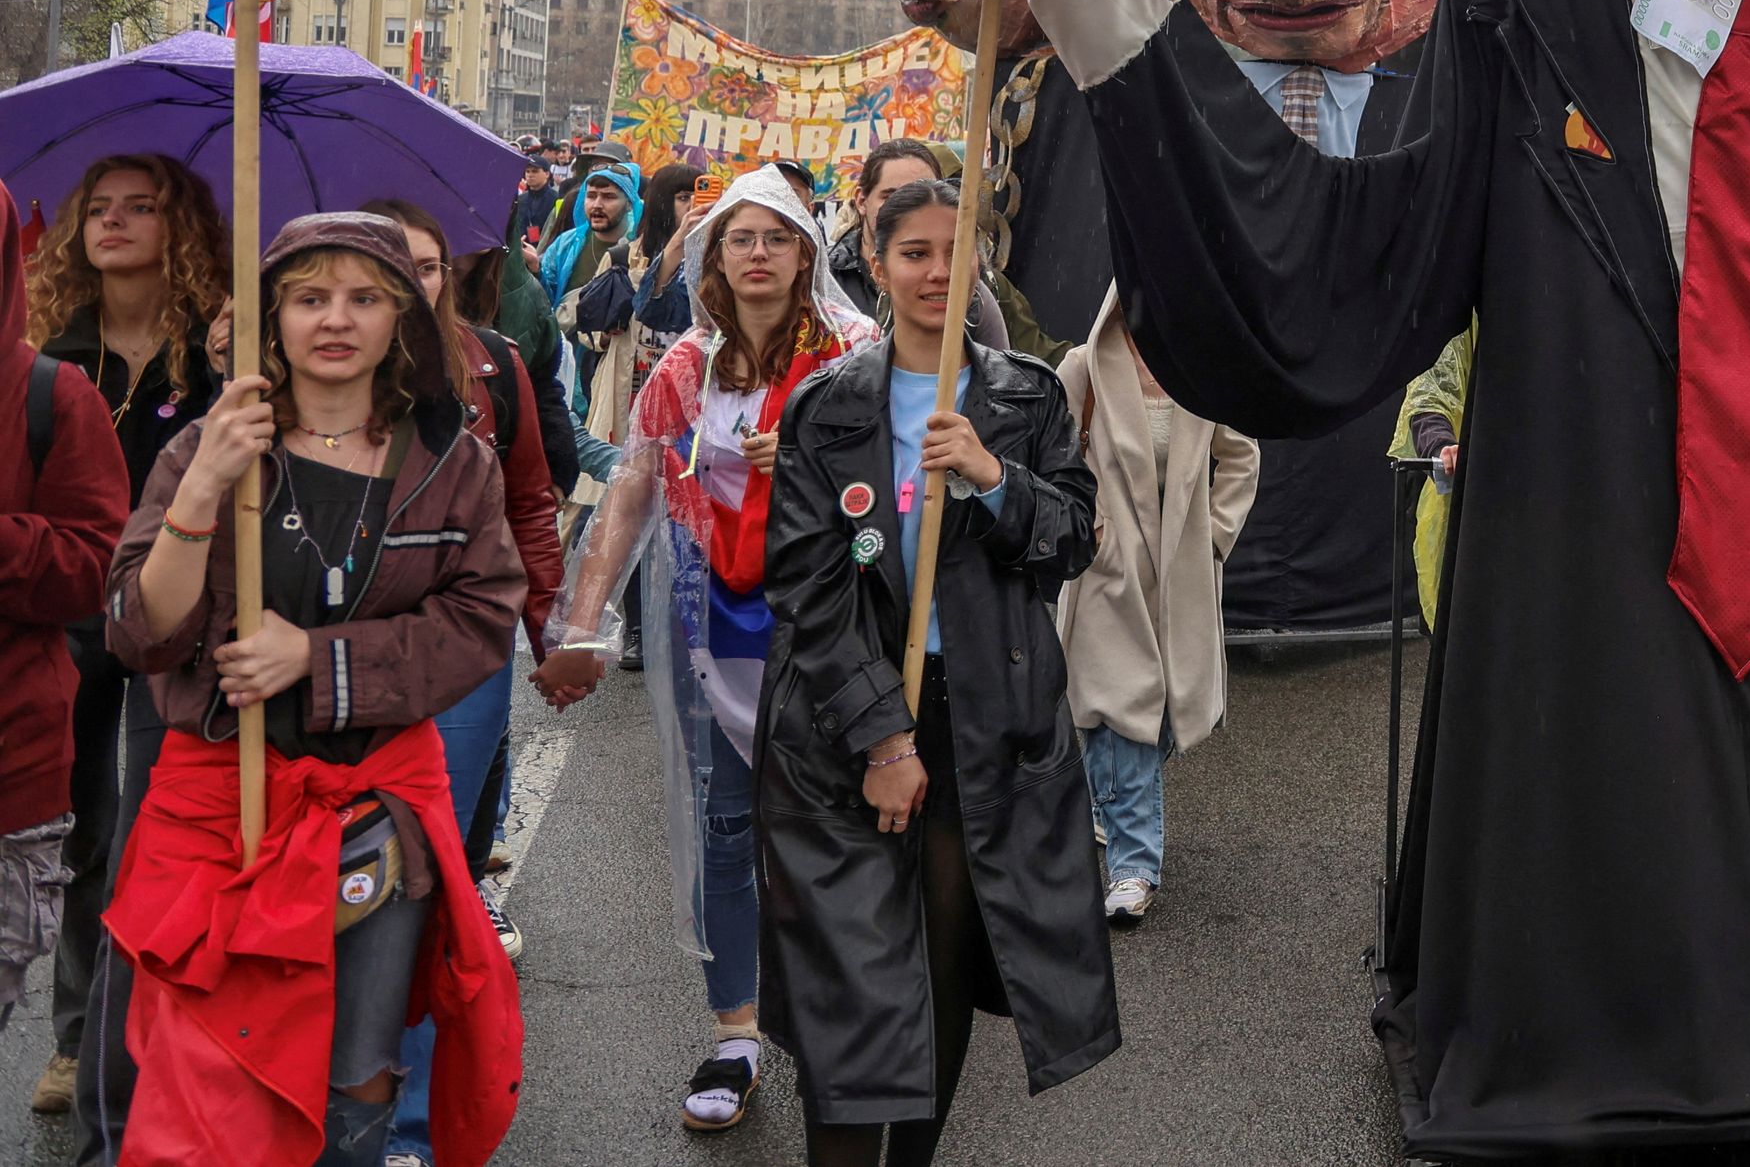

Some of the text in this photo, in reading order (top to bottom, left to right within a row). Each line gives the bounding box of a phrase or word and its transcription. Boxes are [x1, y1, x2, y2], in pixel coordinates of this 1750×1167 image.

[667, 21, 930, 90] МИРИШЕ
[776, 89, 846, 120] НА
[684, 109, 906, 165] ПРАВДУ
